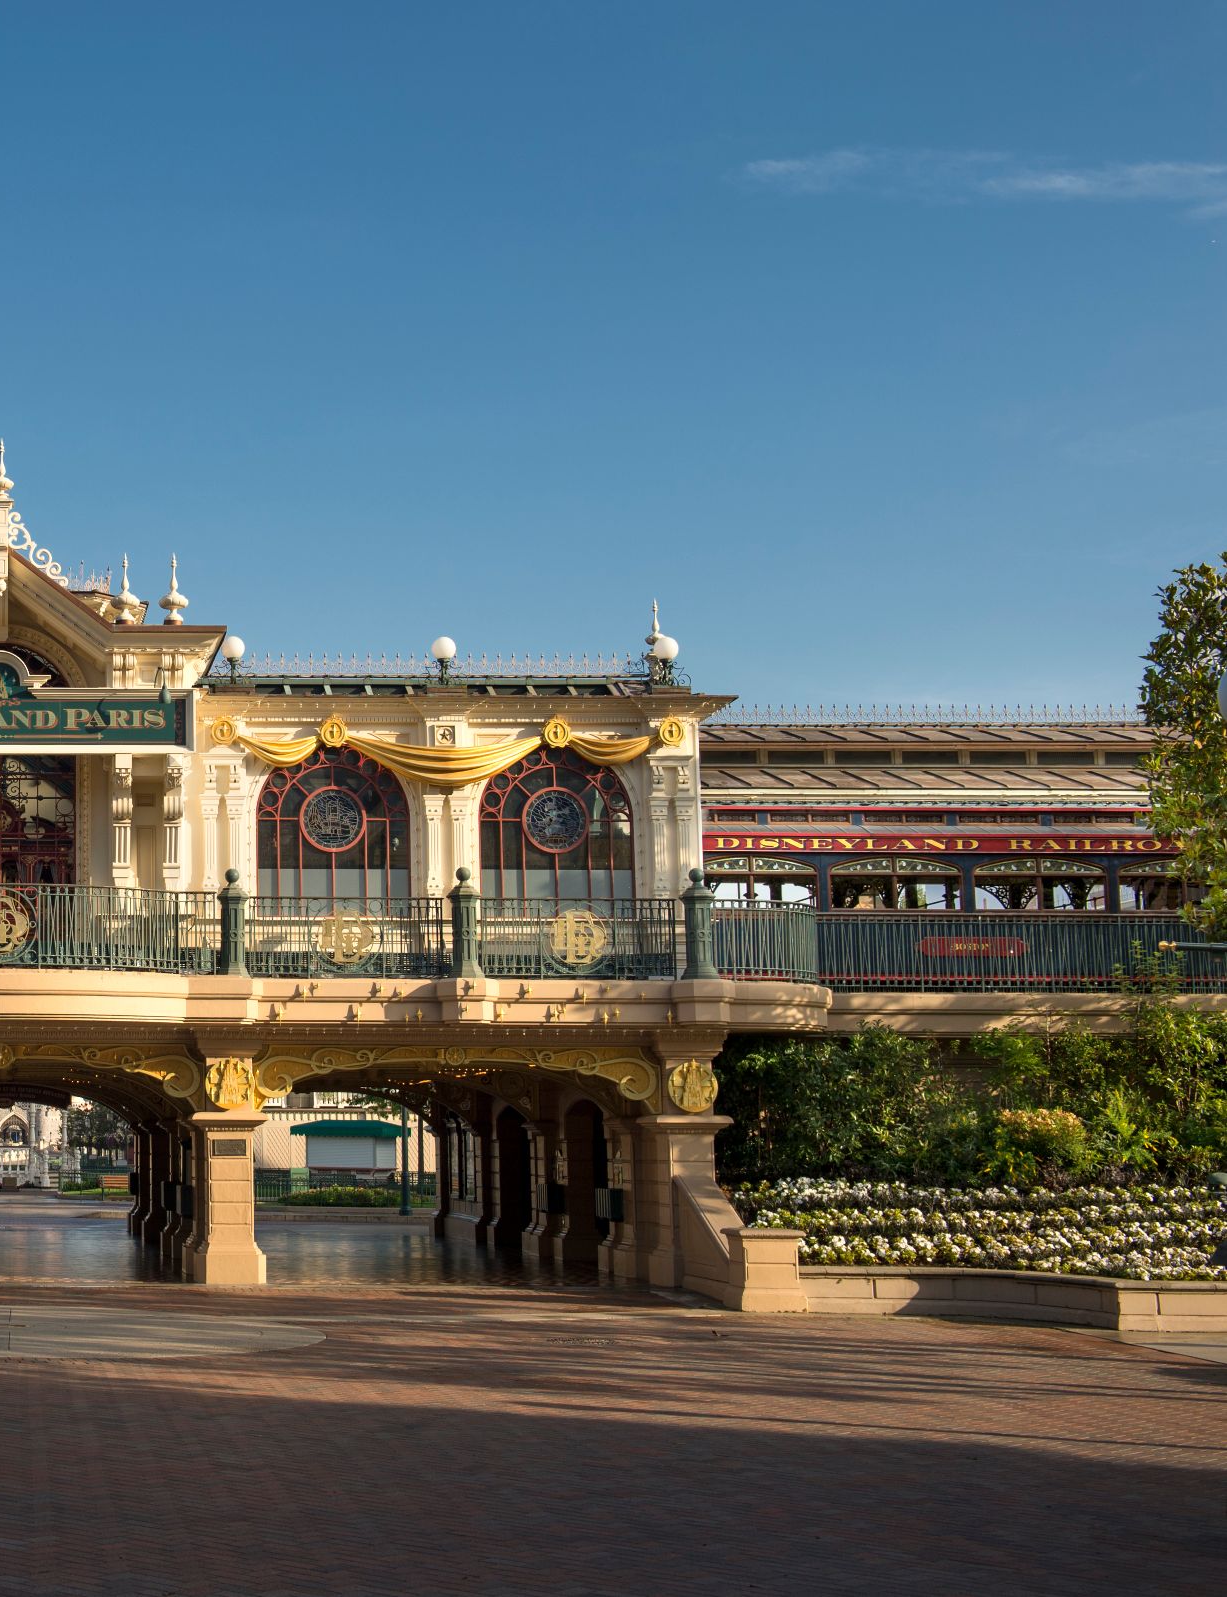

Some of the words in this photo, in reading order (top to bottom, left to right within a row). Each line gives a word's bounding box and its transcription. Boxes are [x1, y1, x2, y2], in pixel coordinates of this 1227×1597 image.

[63, 708, 166, 730] PARIS
[715, 837, 979, 850] DISNEYLAND
[1007, 838, 1185, 851] RAILROA
